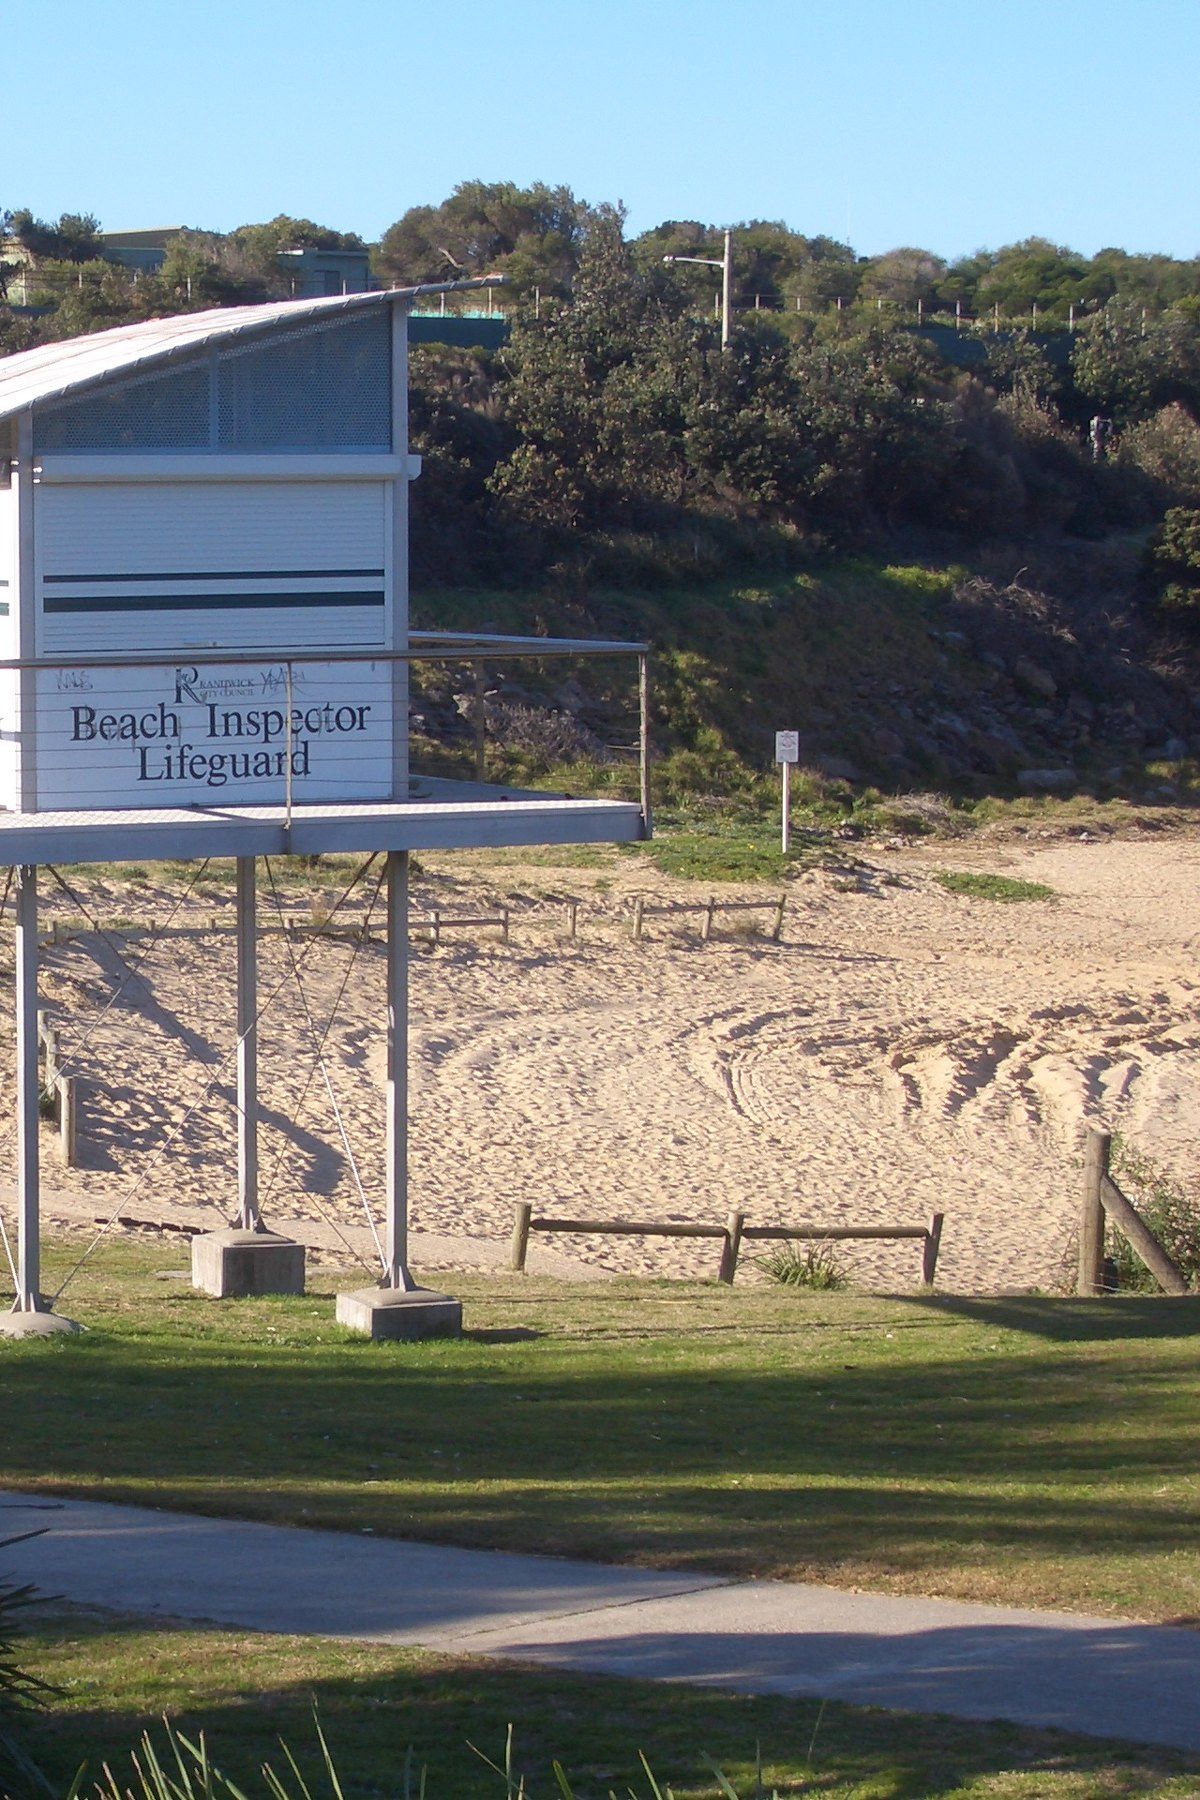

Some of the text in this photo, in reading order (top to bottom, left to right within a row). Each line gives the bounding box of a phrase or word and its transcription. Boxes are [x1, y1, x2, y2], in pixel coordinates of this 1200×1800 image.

[70, 701, 372, 744] Beach Inspector
[136, 740, 311, 787] Lifeguard
